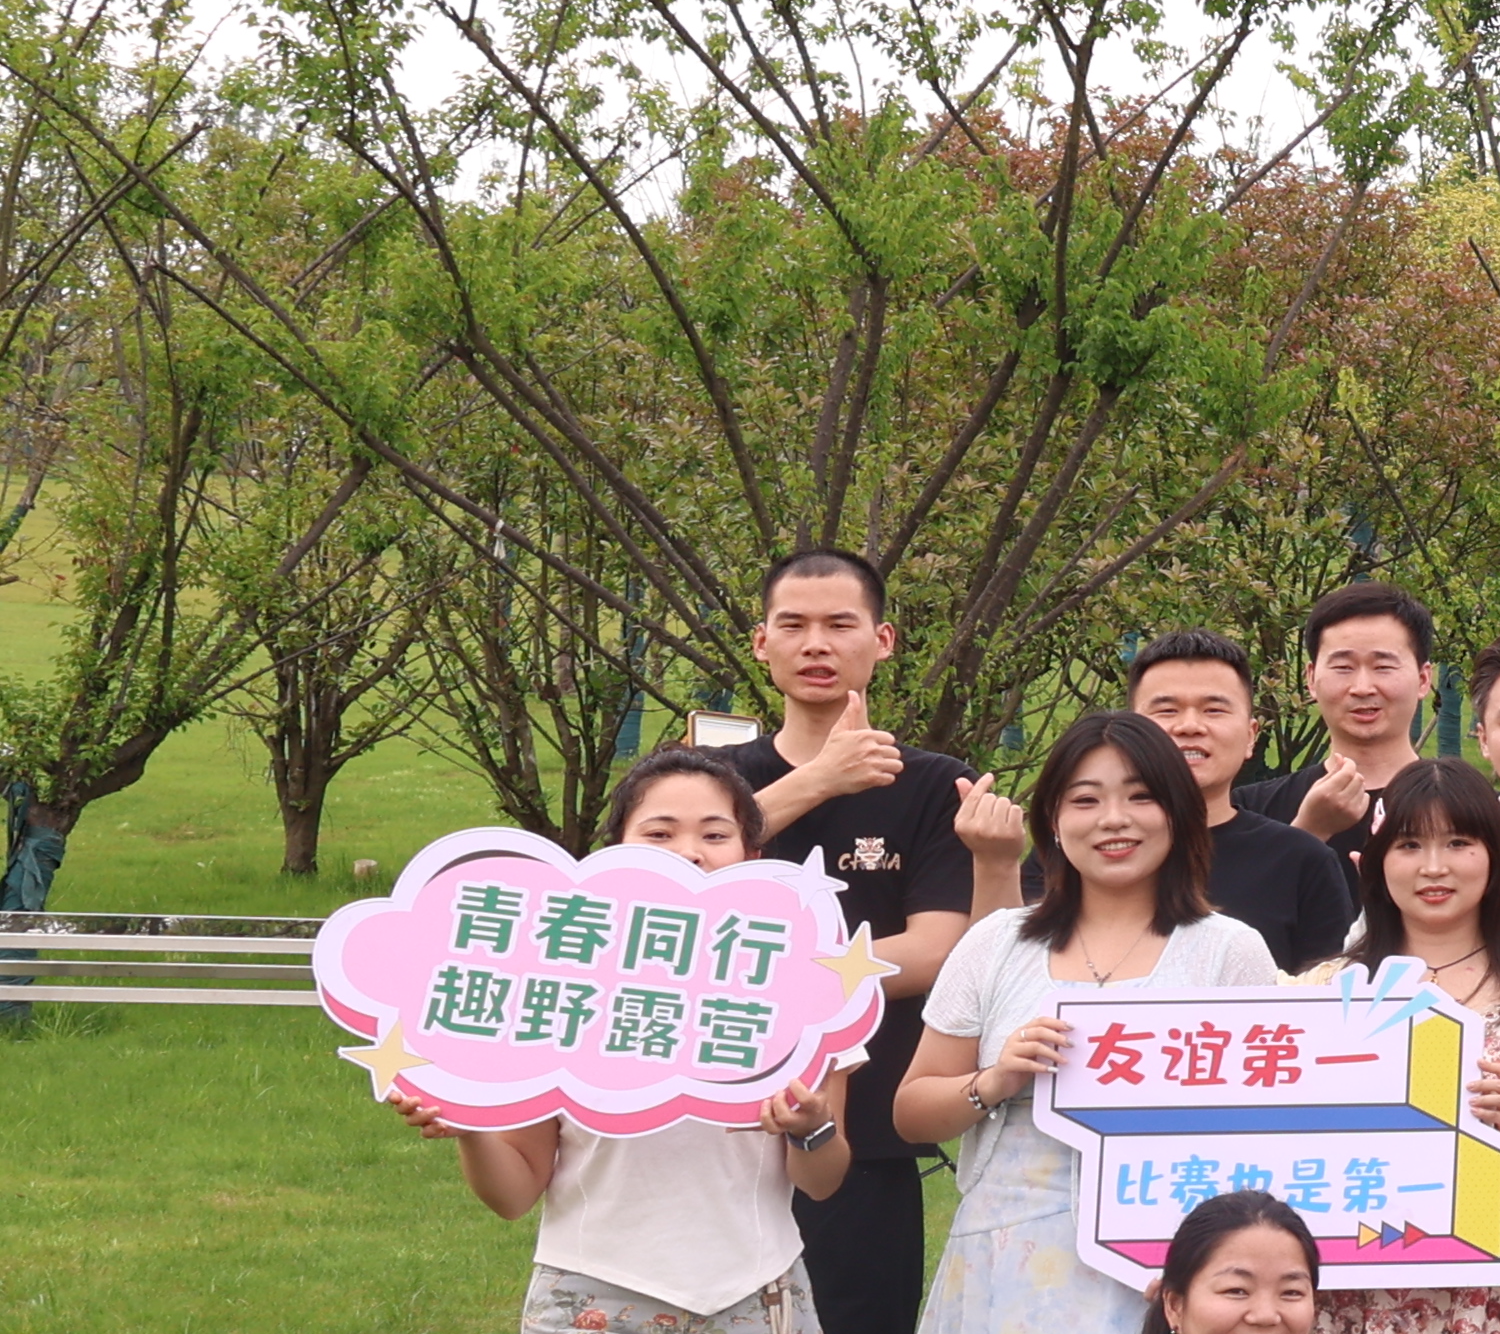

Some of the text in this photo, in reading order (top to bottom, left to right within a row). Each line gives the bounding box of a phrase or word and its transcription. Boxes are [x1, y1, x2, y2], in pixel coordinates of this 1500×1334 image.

[454, 885, 788, 986] 青春同行
[424, 965, 773, 1069] 趣野露营
[1086, 1021, 1380, 1087] 友谊第一
[1116, 1154, 1446, 1213] 比赛也是第一
